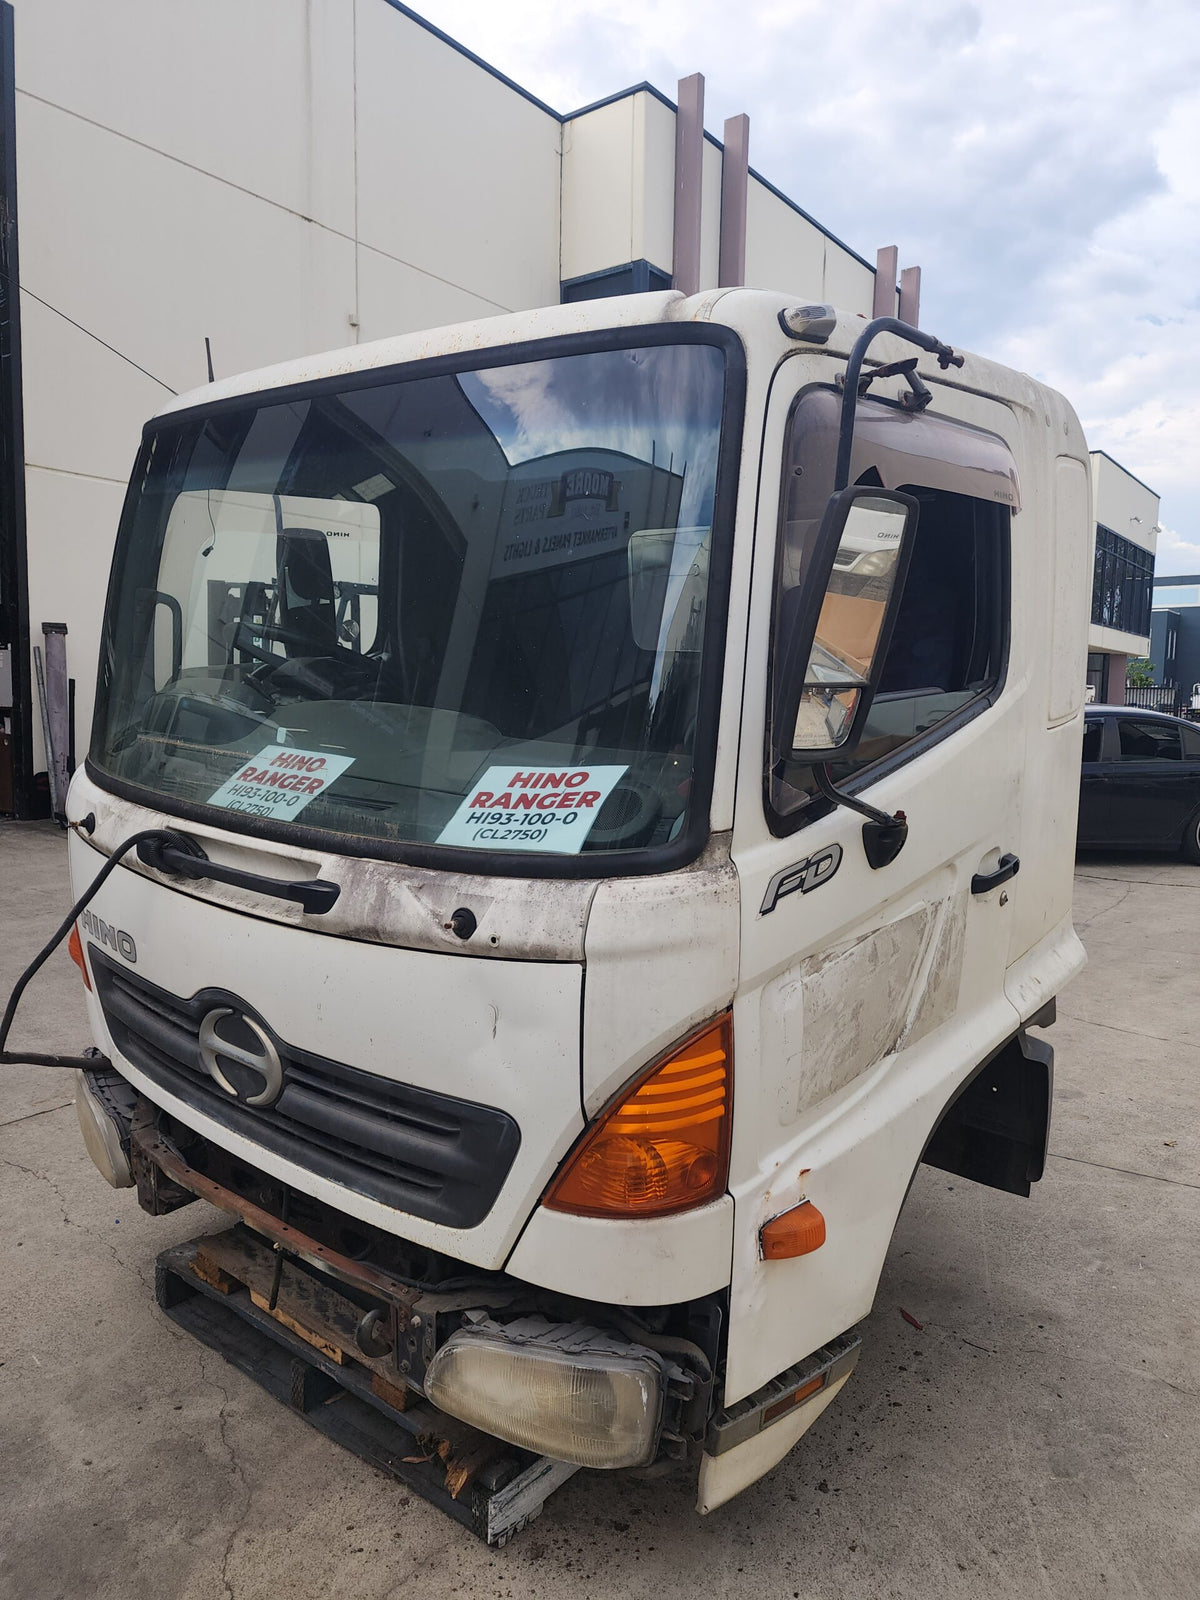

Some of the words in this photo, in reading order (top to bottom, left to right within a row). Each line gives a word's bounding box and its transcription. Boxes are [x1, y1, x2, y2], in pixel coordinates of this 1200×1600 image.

[269, 752, 327, 772] HINO
[236, 766, 325, 795] RANGER
[507, 771, 590, 789] HINO
[469, 791, 601, 810] RANGER
[472, 828, 548, 842] (CL2750)
[759, 843, 843, 916] FD
[81, 909, 137, 963] HINO
